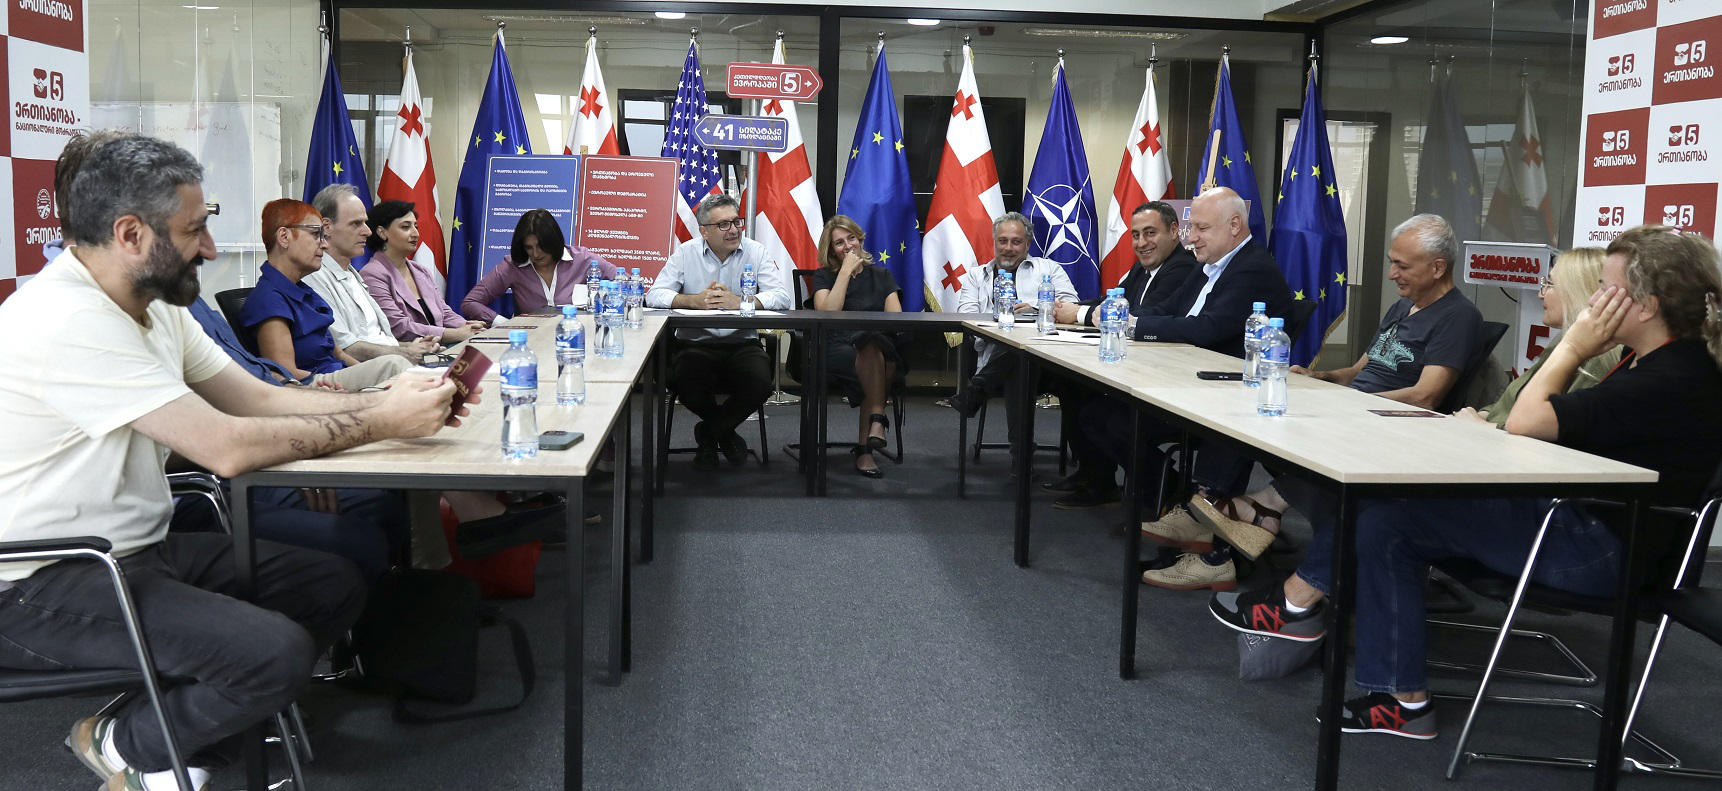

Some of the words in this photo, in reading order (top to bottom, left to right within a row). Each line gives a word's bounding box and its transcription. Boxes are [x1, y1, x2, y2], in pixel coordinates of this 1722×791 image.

[19, 0, 73, 21] ერთიანობა
[1603, 0, 1648, 18] ერთიანობა
[1692, 41, 1705, 63] 5
[1623, 54, 1634, 74] 5
[783, 73, 798, 92] 5
[1664, 66, 1714, 83] ერთიანობა
[51, 73, 63, 101] 5
[734, 80, 778, 89] ევროპაში
[1598, 77, 1642, 93] ერთიანობა
[16, 102, 75, 124] ერთიანობა
[712, 123, 734, 141] 41
[739, 126, 782, 135] სიღატაკე
[1686, 125, 1698, 145] 5
[1618, 131, 1629, 150] 5
[1593, 154, 1637, 168] ერთიანობა
[1658, 150, 1708, 163] ერთიანობა
[1612, 207, 1624, 226] 5
[1681, 206, 1693, 226] 5
[26, 226, 62, 245] ერთიან
[1252, 603, 1287, 633] AX
[1370, 704, 1408, 729] AX
